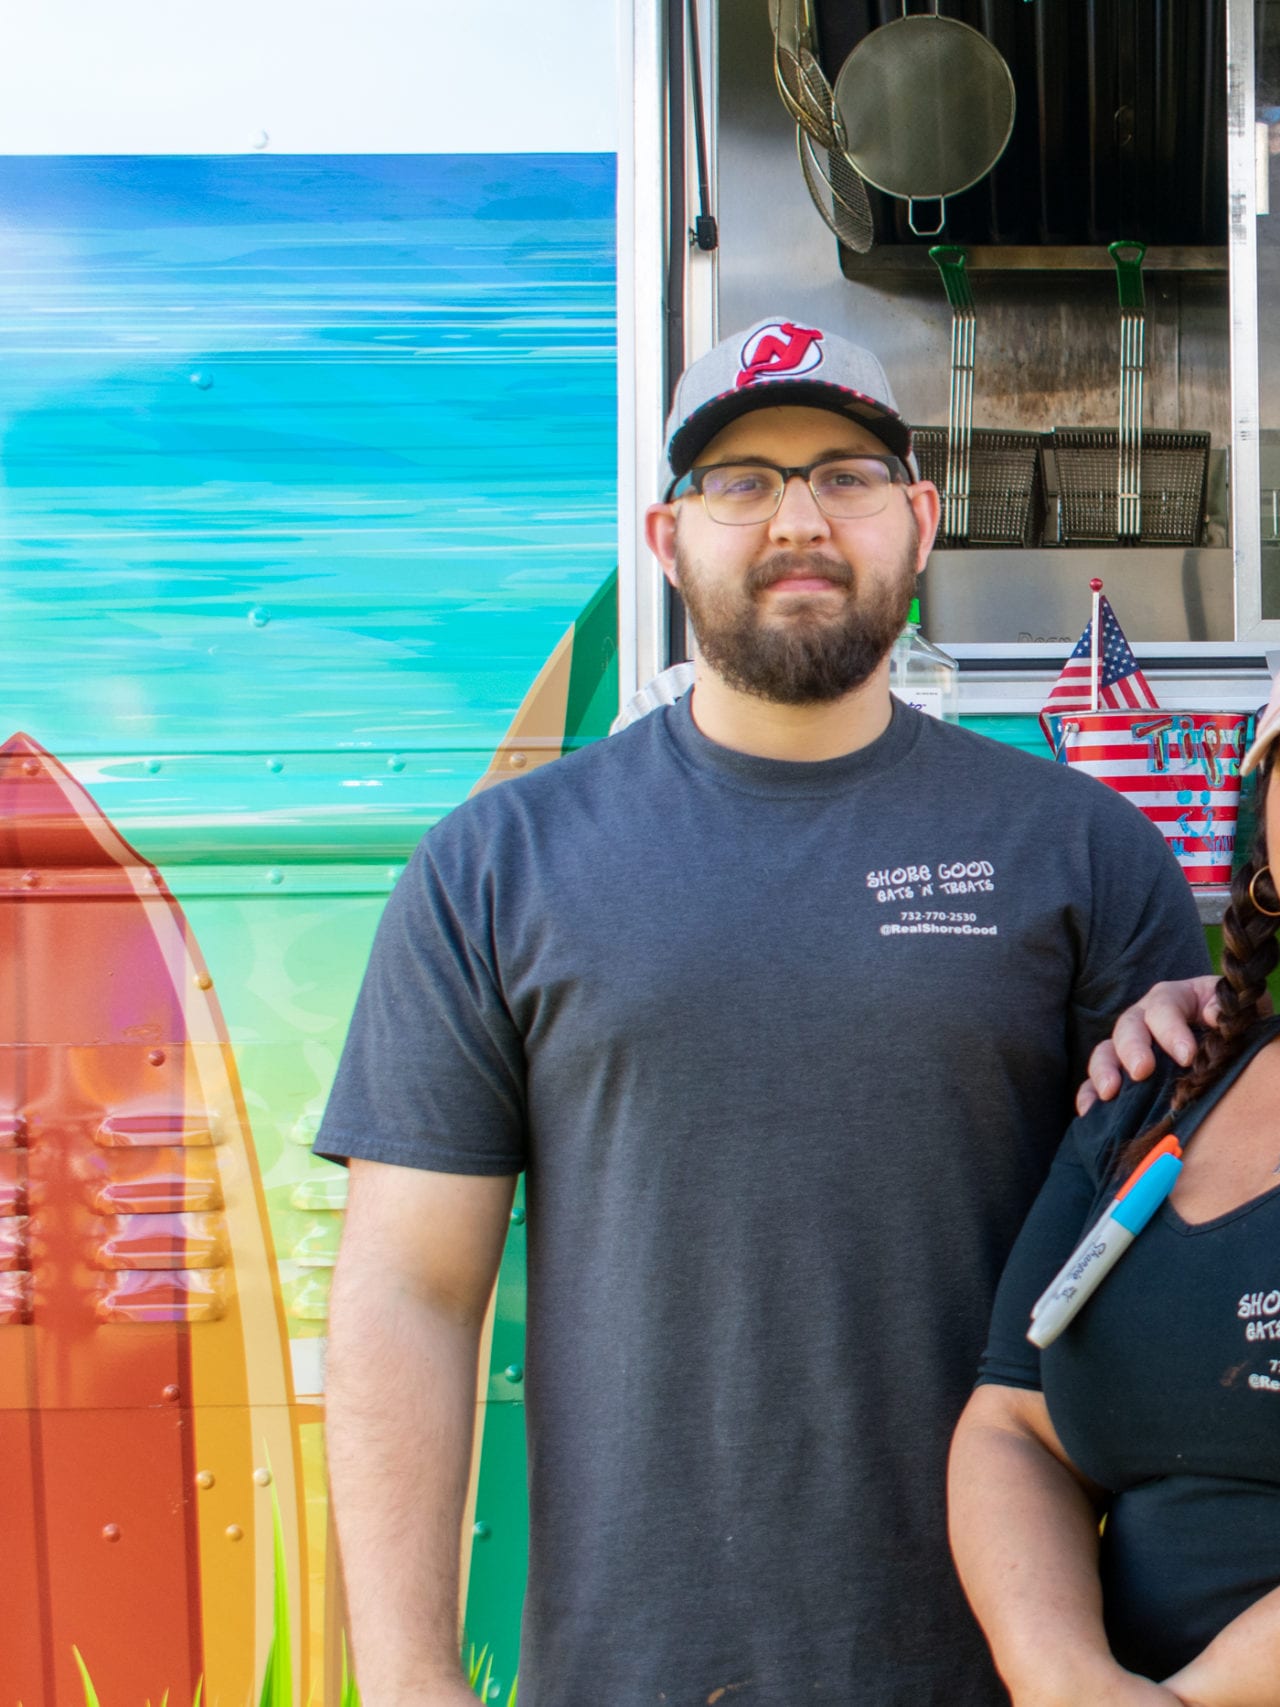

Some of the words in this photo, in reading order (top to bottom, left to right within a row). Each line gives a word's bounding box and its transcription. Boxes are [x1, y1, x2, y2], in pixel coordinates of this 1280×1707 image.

[938, 861, 995, 879] GOOD
[900, 911, 977, 922] 732-770-2530
[880, 924, 998, 936] @RealShoreGood
